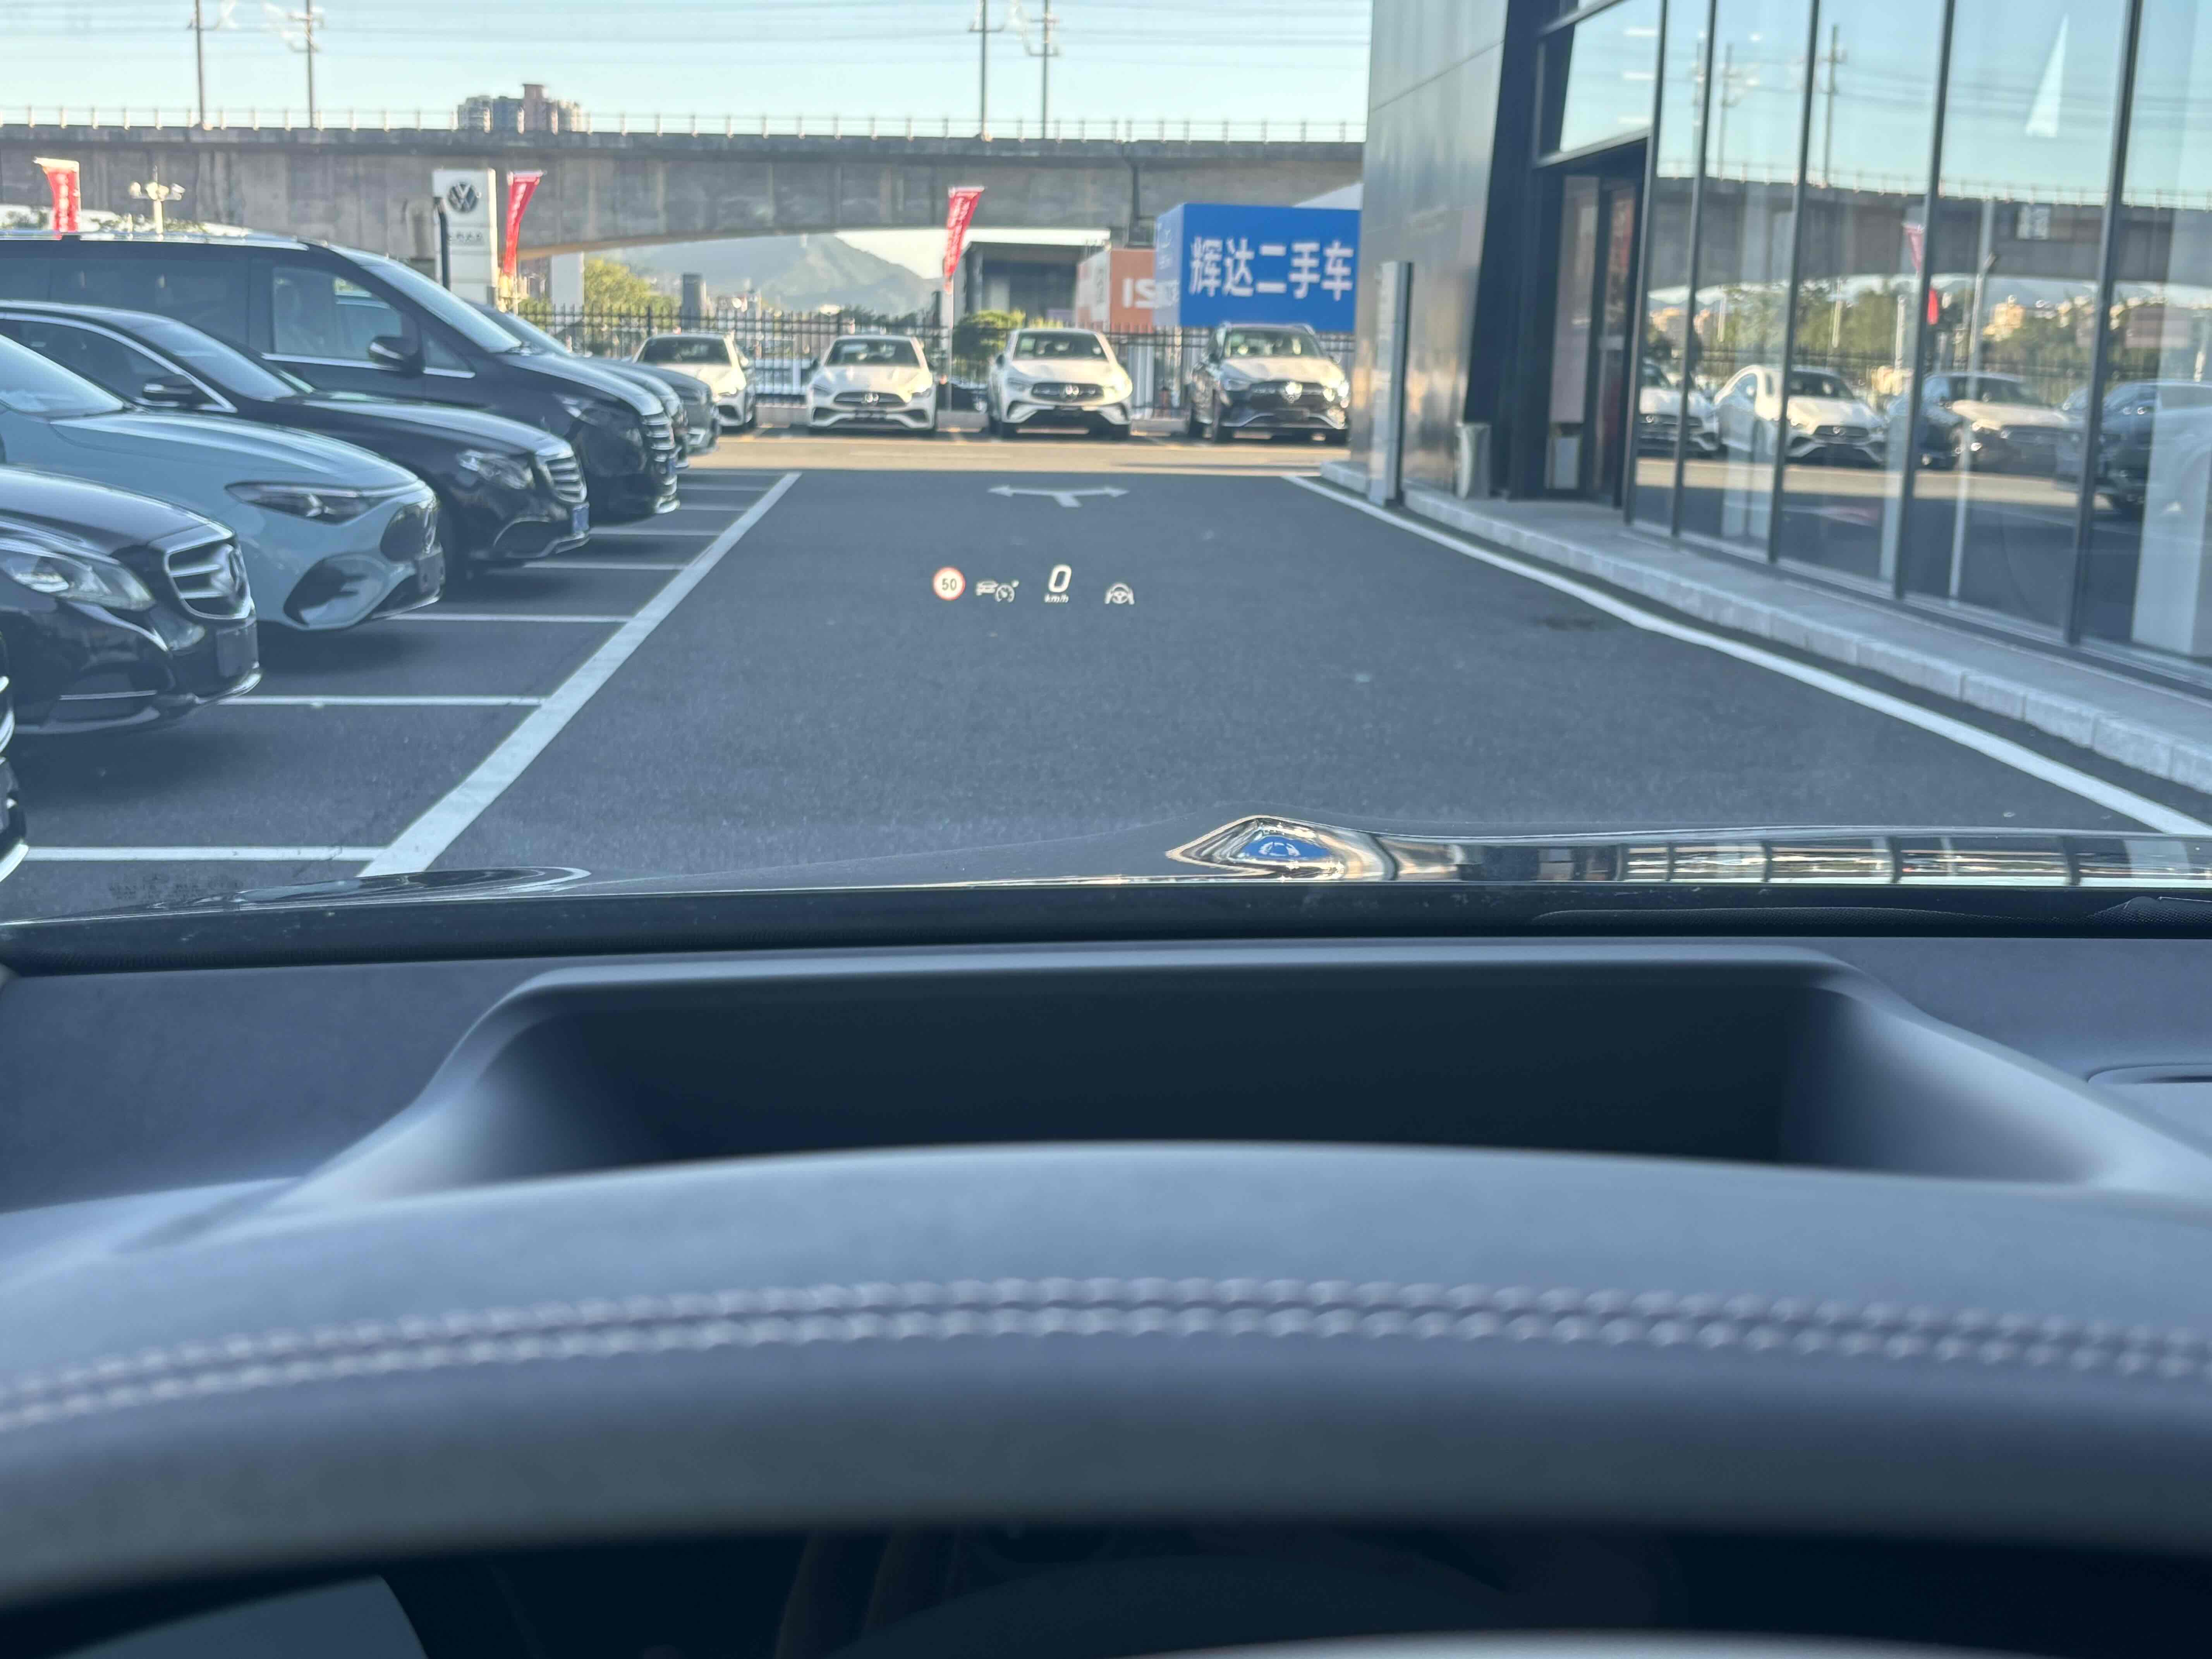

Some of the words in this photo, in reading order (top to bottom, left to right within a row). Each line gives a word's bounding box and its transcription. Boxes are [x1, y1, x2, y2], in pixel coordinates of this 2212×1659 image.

[1189, 235, 1354, 301] 辉达二手车
[941, 579, 957, 590] 50
[1048, 564, 1072, 592] 0
[1044, 594, 1069, 603] km/h
